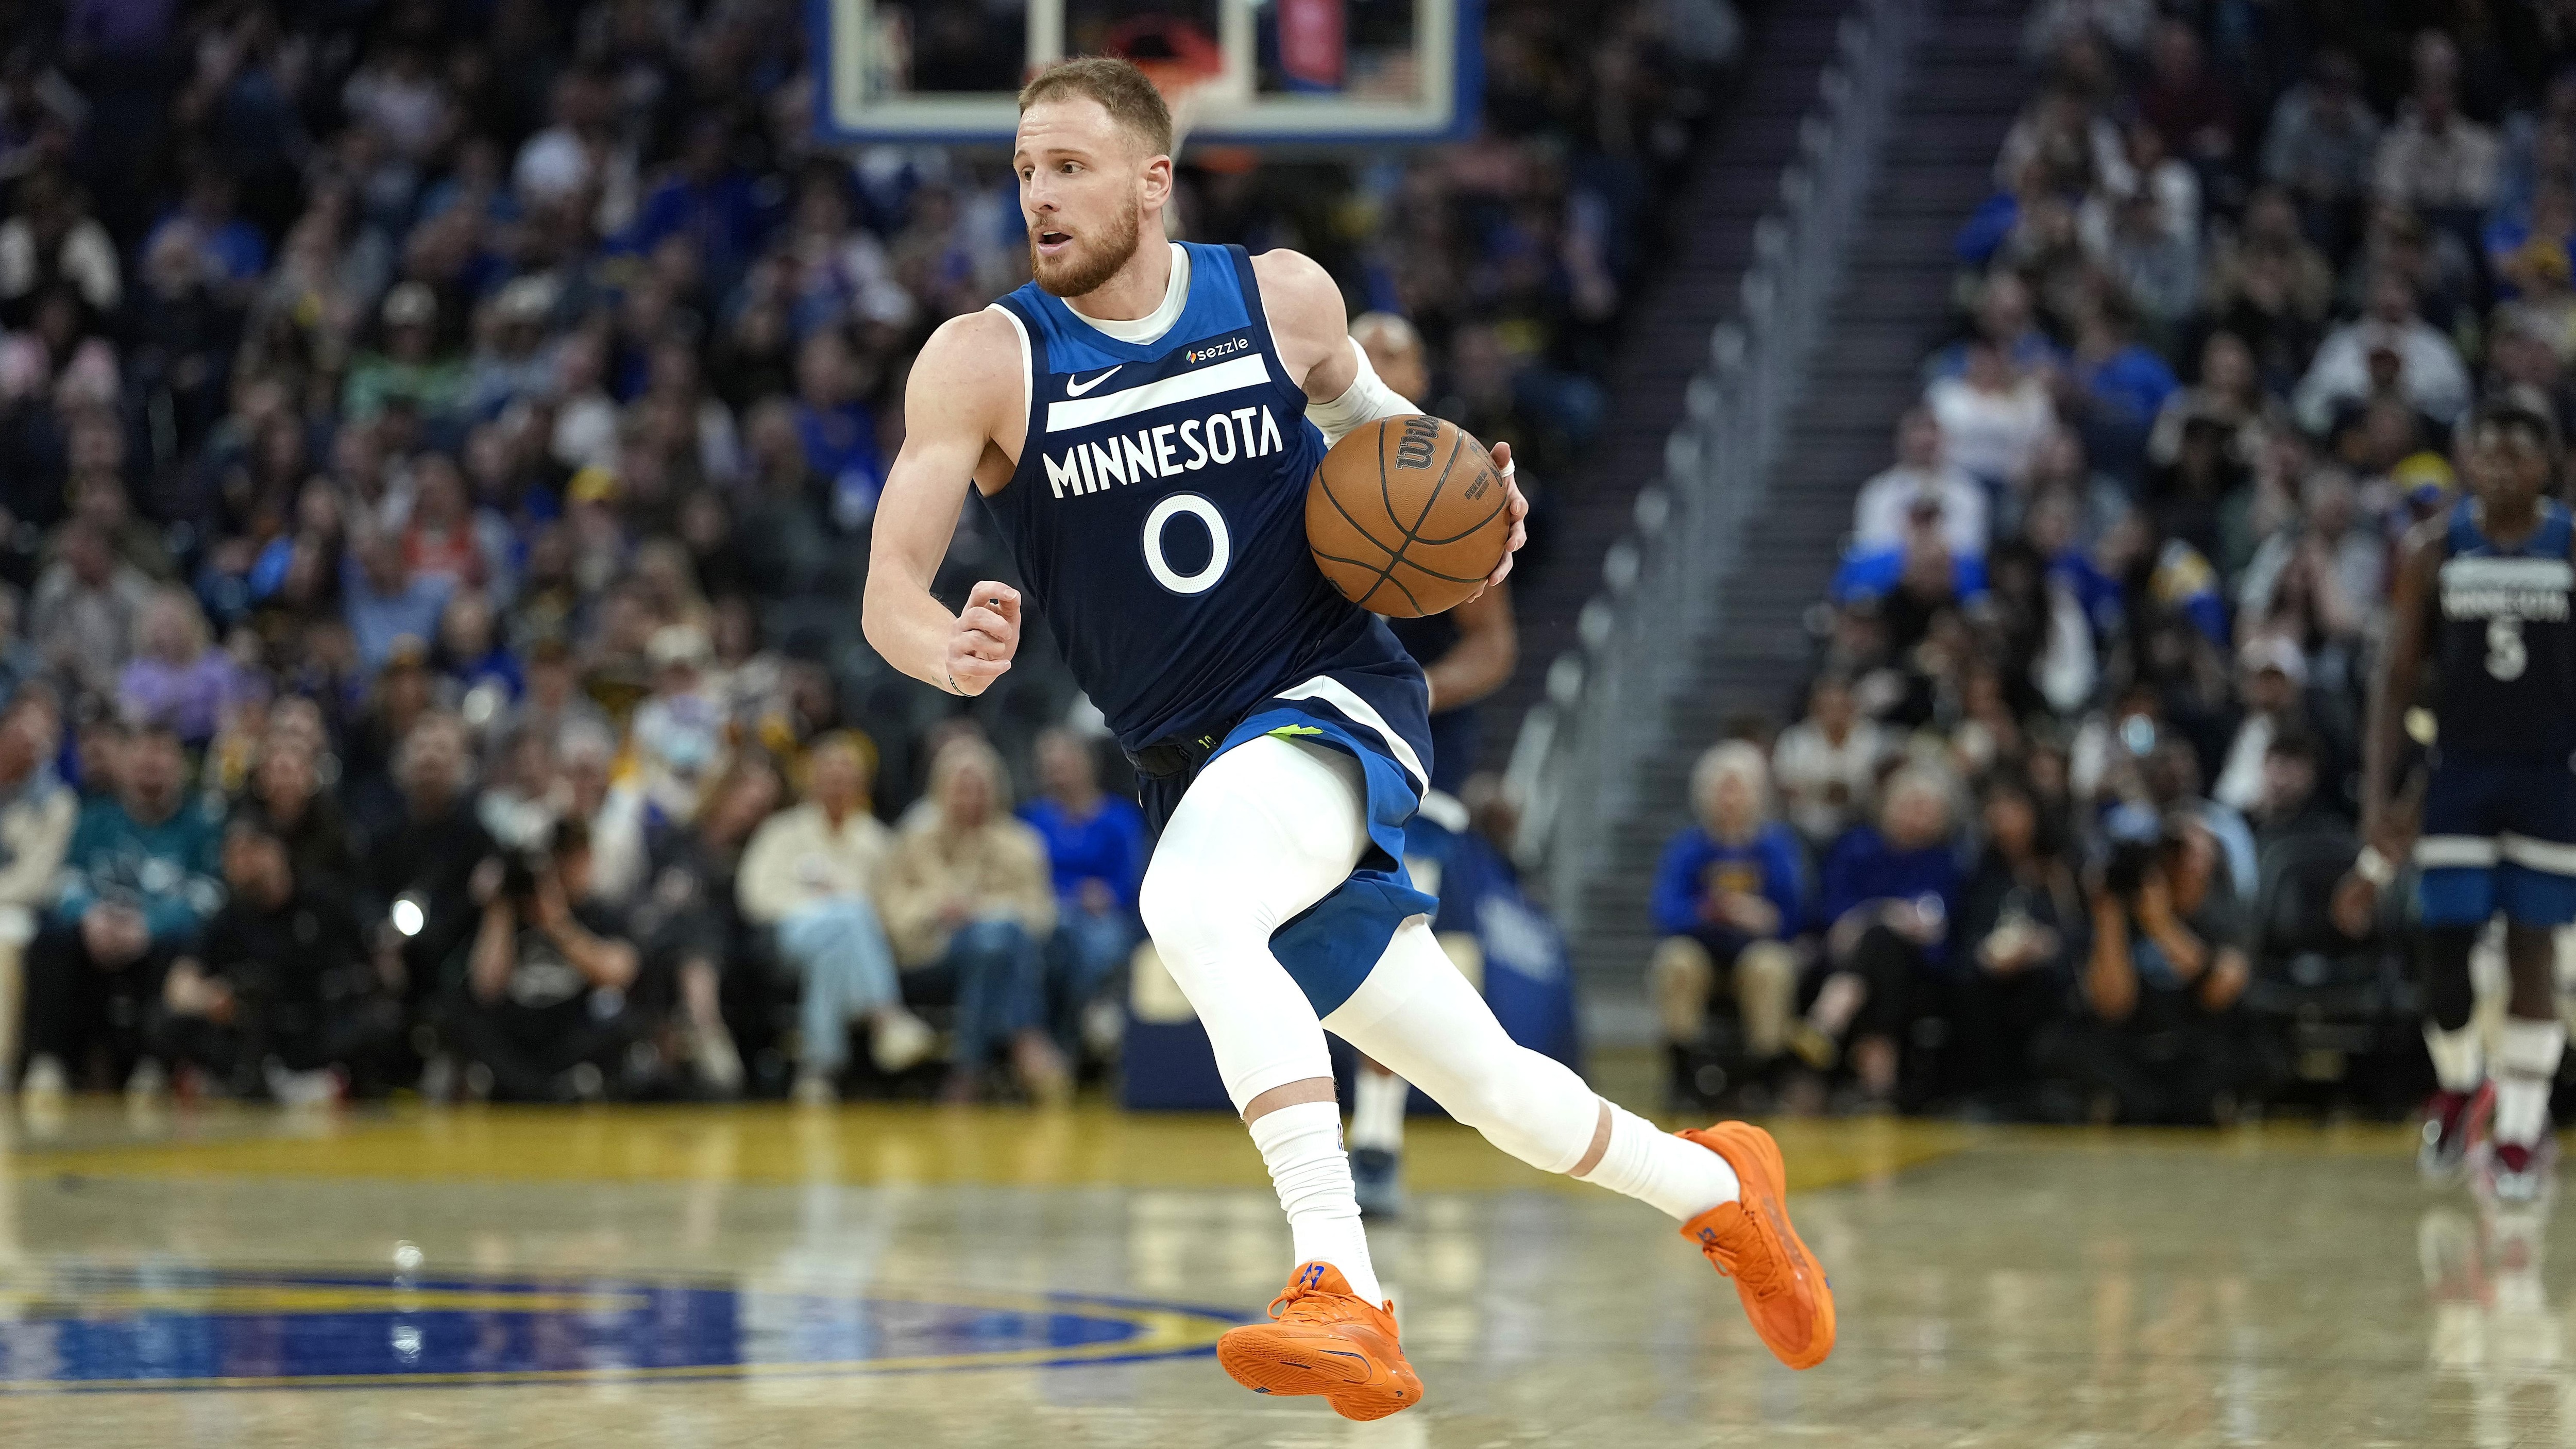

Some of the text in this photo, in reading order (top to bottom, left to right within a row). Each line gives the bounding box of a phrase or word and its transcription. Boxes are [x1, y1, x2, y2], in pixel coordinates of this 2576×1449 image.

[1197, 337, 1248, 361] sezzle
[1043, 405, 1283, 499] MINNESOTA
[1140, 491, 1233, 597] 0
